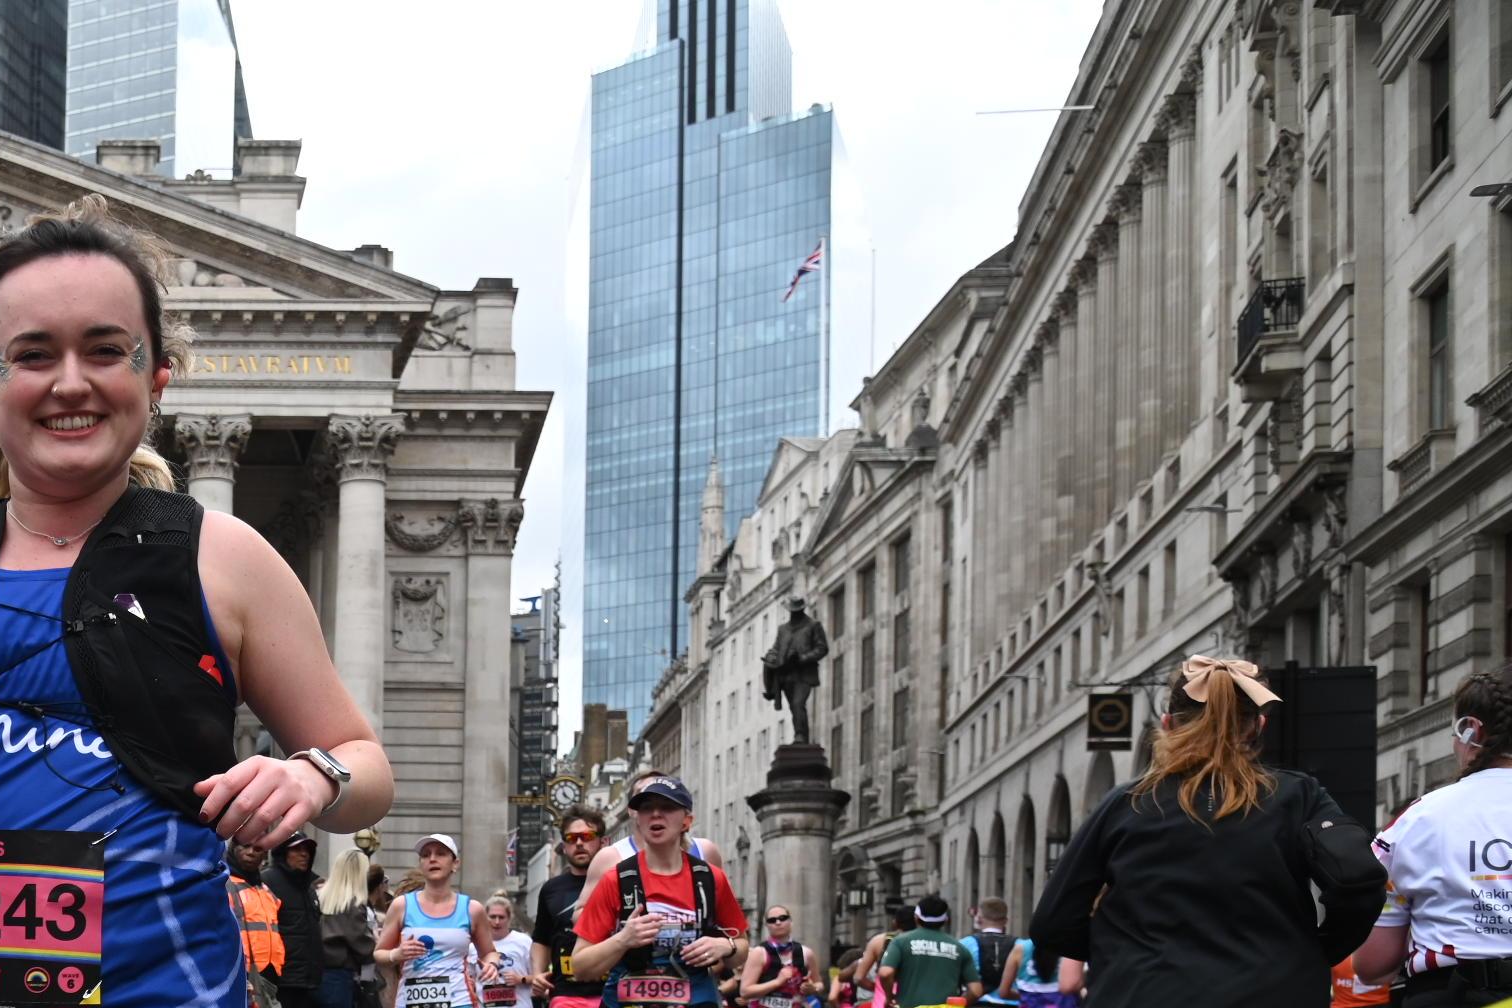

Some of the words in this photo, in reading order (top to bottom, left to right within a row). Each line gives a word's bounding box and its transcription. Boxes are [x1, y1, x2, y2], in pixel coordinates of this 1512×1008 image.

[1472, 900, 1512, 912] disco
[1474, 913, 1503, 925] that
[66, 979, 75, 989] 6
[623, 980, 686, 998] 14998
[406, 986, 448, 1002] 20034
